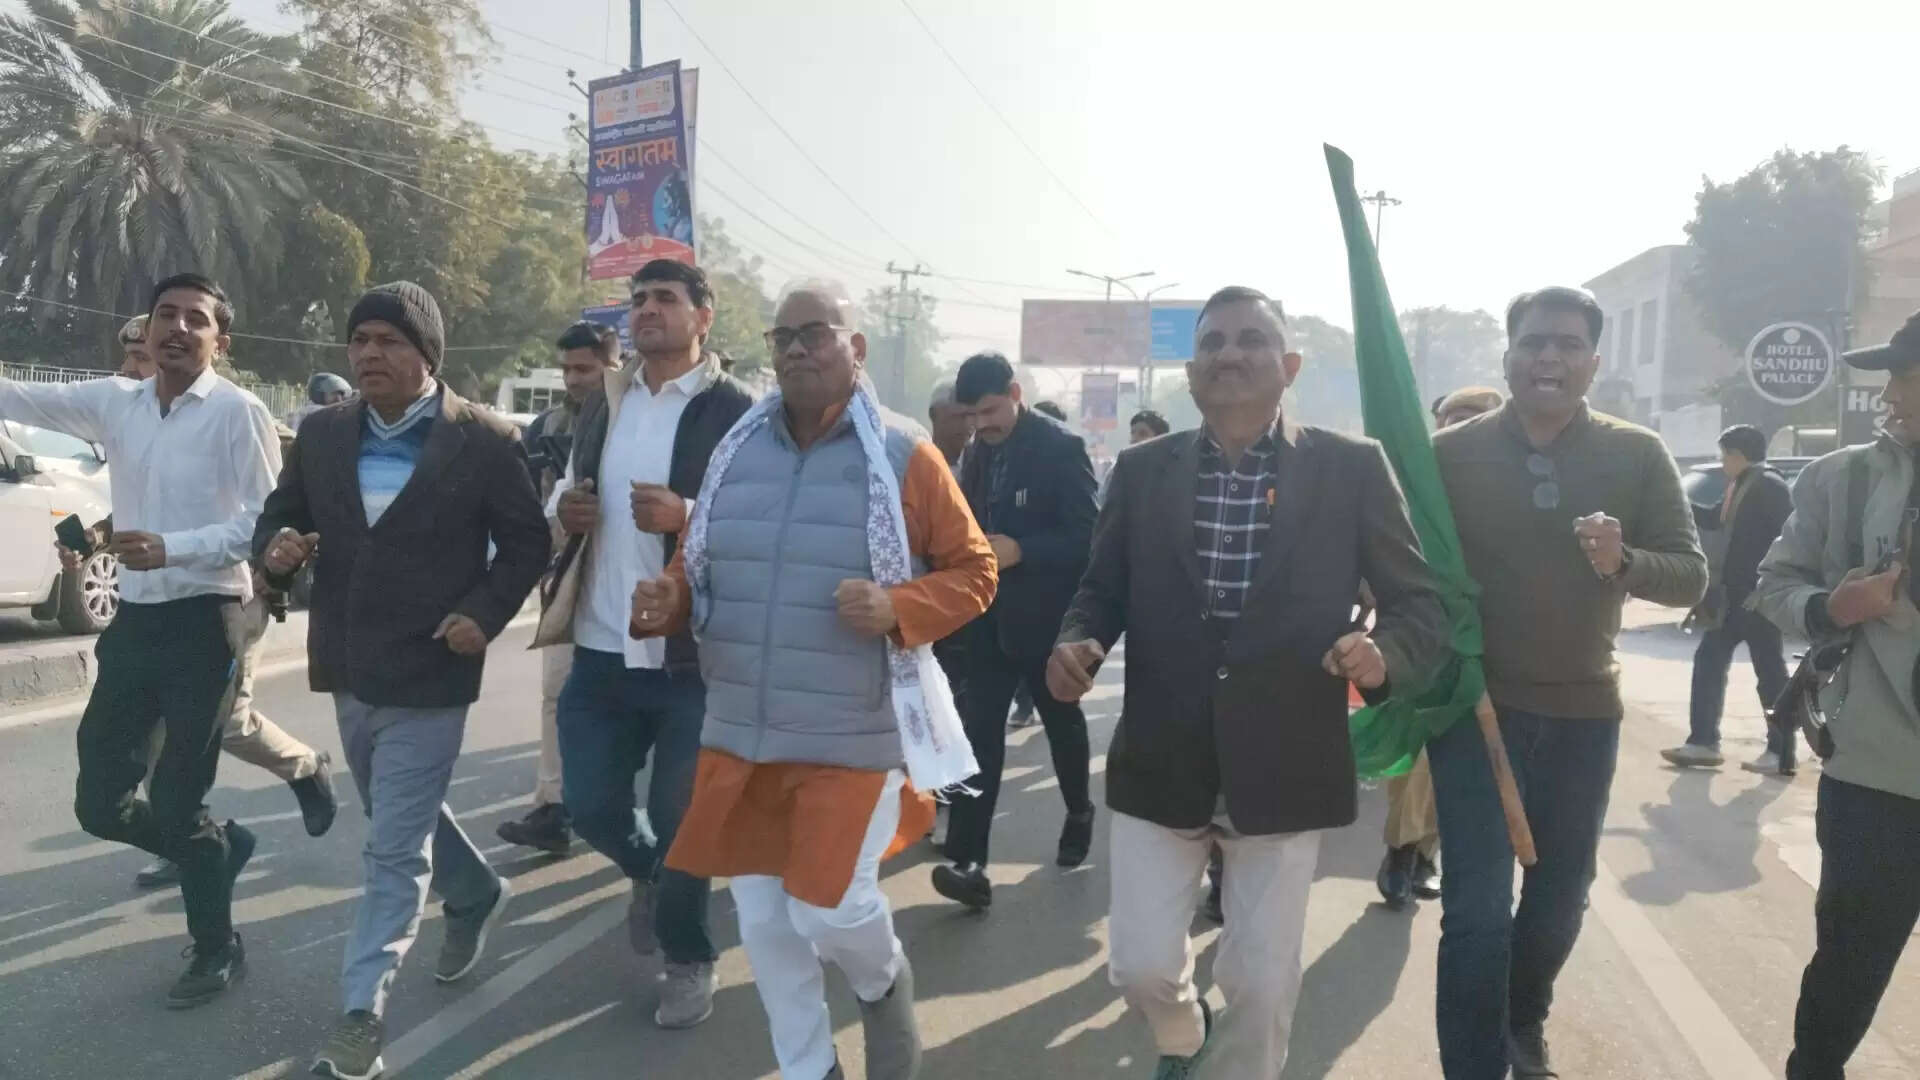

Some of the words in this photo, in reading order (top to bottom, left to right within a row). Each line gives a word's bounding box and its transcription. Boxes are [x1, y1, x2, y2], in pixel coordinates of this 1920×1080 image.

[594, 136, 680, 172] स्वागतम्
[1767, 344, 1814, 355] HOTEL
[1753, 357, 1827, 371] SANDHU
[1761, 373, 1817, 384] PALACE
